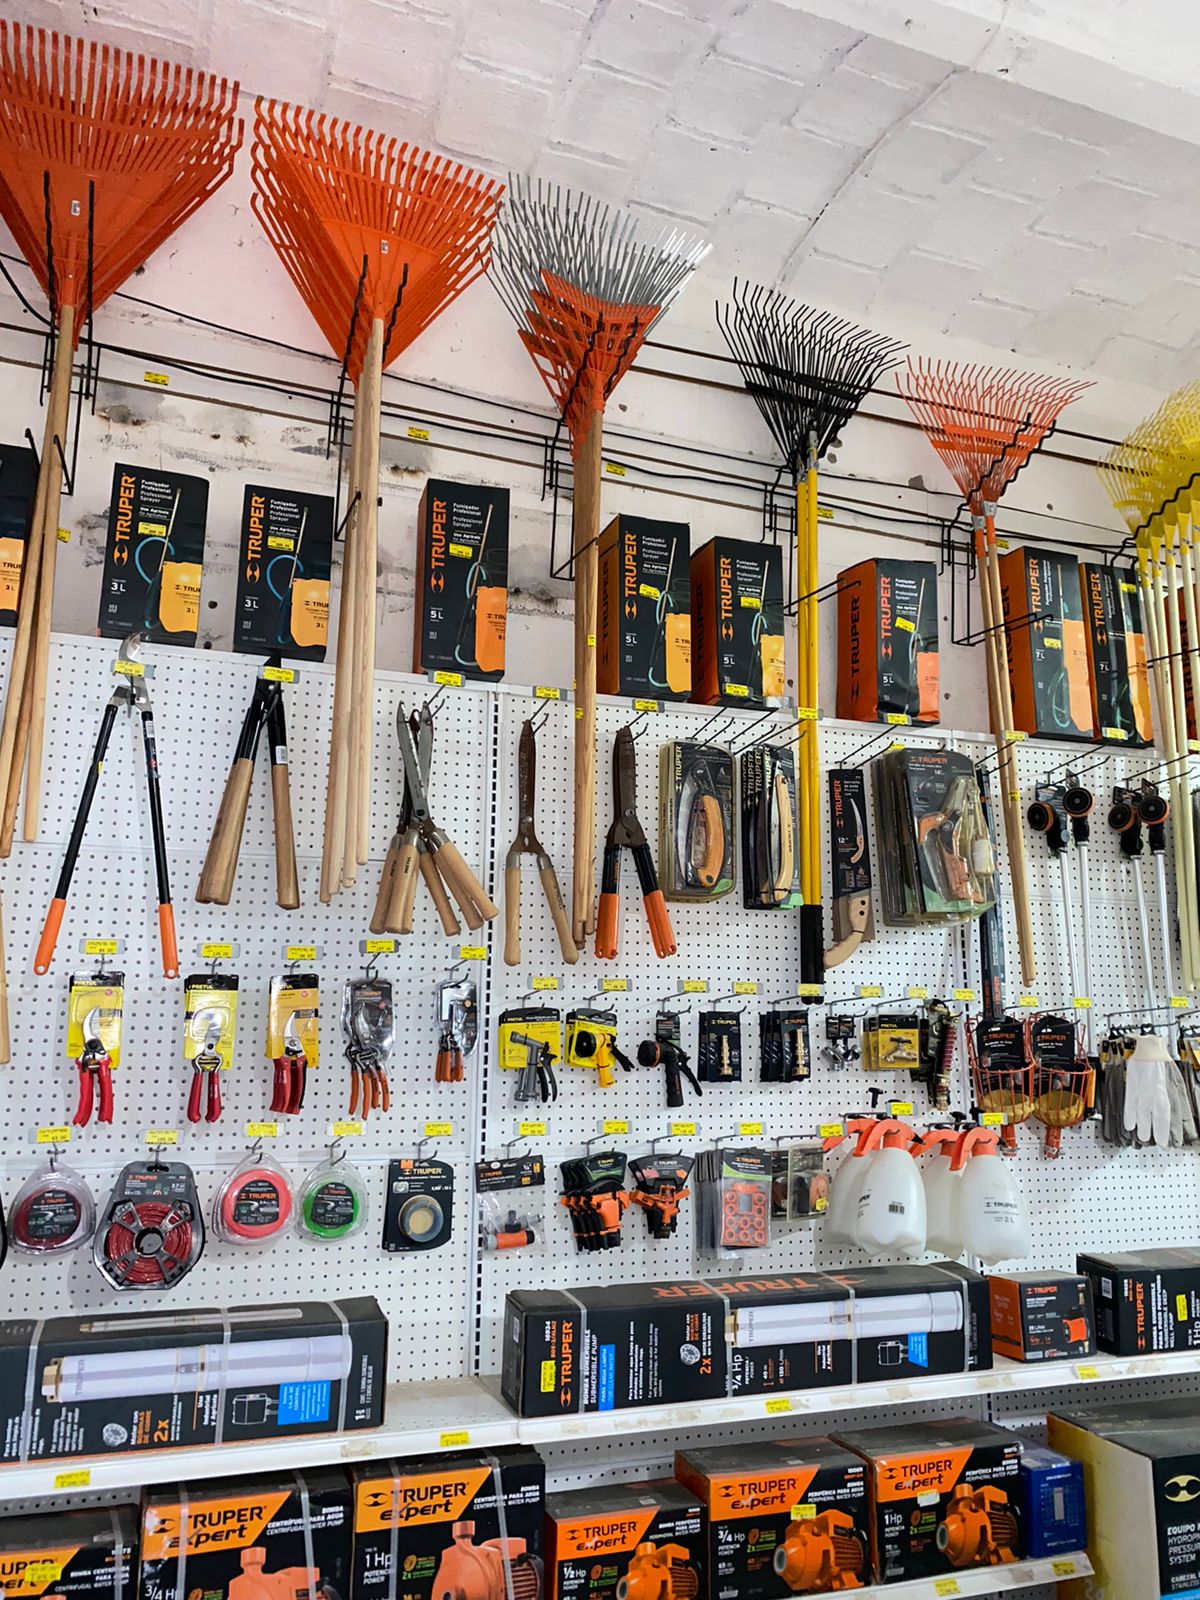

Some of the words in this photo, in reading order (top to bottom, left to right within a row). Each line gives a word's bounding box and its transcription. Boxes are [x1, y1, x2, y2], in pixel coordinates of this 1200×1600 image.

[141, 485, 171, 493] Profesional
[142, 480, 169, 488] Fumigador
[140, 491, 172, 499] Professional
[116, 474, 136, 542] TRUPER
[270, 510, 300, 518] Professional
[453, 503, 480, 511] Fumigador
[248, 496, 265, 560] TRUPER
[432, 500, 446, 569] TRUPER
[625, 533, 637, 597] TRUPER
[111, 582, 118, 590] 3
[720, 557, 733, 620] TRUPER
[1030, 559, 1042, 616] TRUPER
[881, 576, 891, 638] TRUPER
[1092, 573, 1105, 627] TRUPER
[852, 596, 860, 678] TRUPER
[834, 780, 842, 816] TRUPER
[651, 1278, 818, 1297] TRUPER
[1136, 1282, 1145, 1334] TRUPER
[561, 1322, 573, 1386] TRUPER
[732, 1354, 743, 1371] Hp
[700, 1358, 711, 1375] 2x
[732, 1375, 742, 1390] 3/4
[154, 1419, 169, 1442] 2x
[901, 1459, 952, 1478] TRUPER
[391, 1482, 467, 1504] TRUPER
[739, 1478, 796, 1495] TRUPER
[322, 1505, 344, 1514] BOMBA
[884, 1514, 889, 1525] 1
[890, 1513, 903, 1525] Hp
[584, 1521, 636, 1539] TRUPER
[718, 1530, 732, 1543] 3/4
[734, 1533, 745, 1542] Hp
[1167, 1524, 1195, 1535] EQUIPO
[365, 1554, 370, 1568] 1
[374, 1552, 392, 1568] Hp
[1169, 1553, 1196, 1565] SYSTEM
[363, 1576, 385, 1585] POWER
[564, 1566, 574, 1579] 1/2
[576, 1568, 586, 1579] Hp
[1171, 1573, 1197, 1583] CABEZAL
[144, 1585, 163, 1600] 3/4
